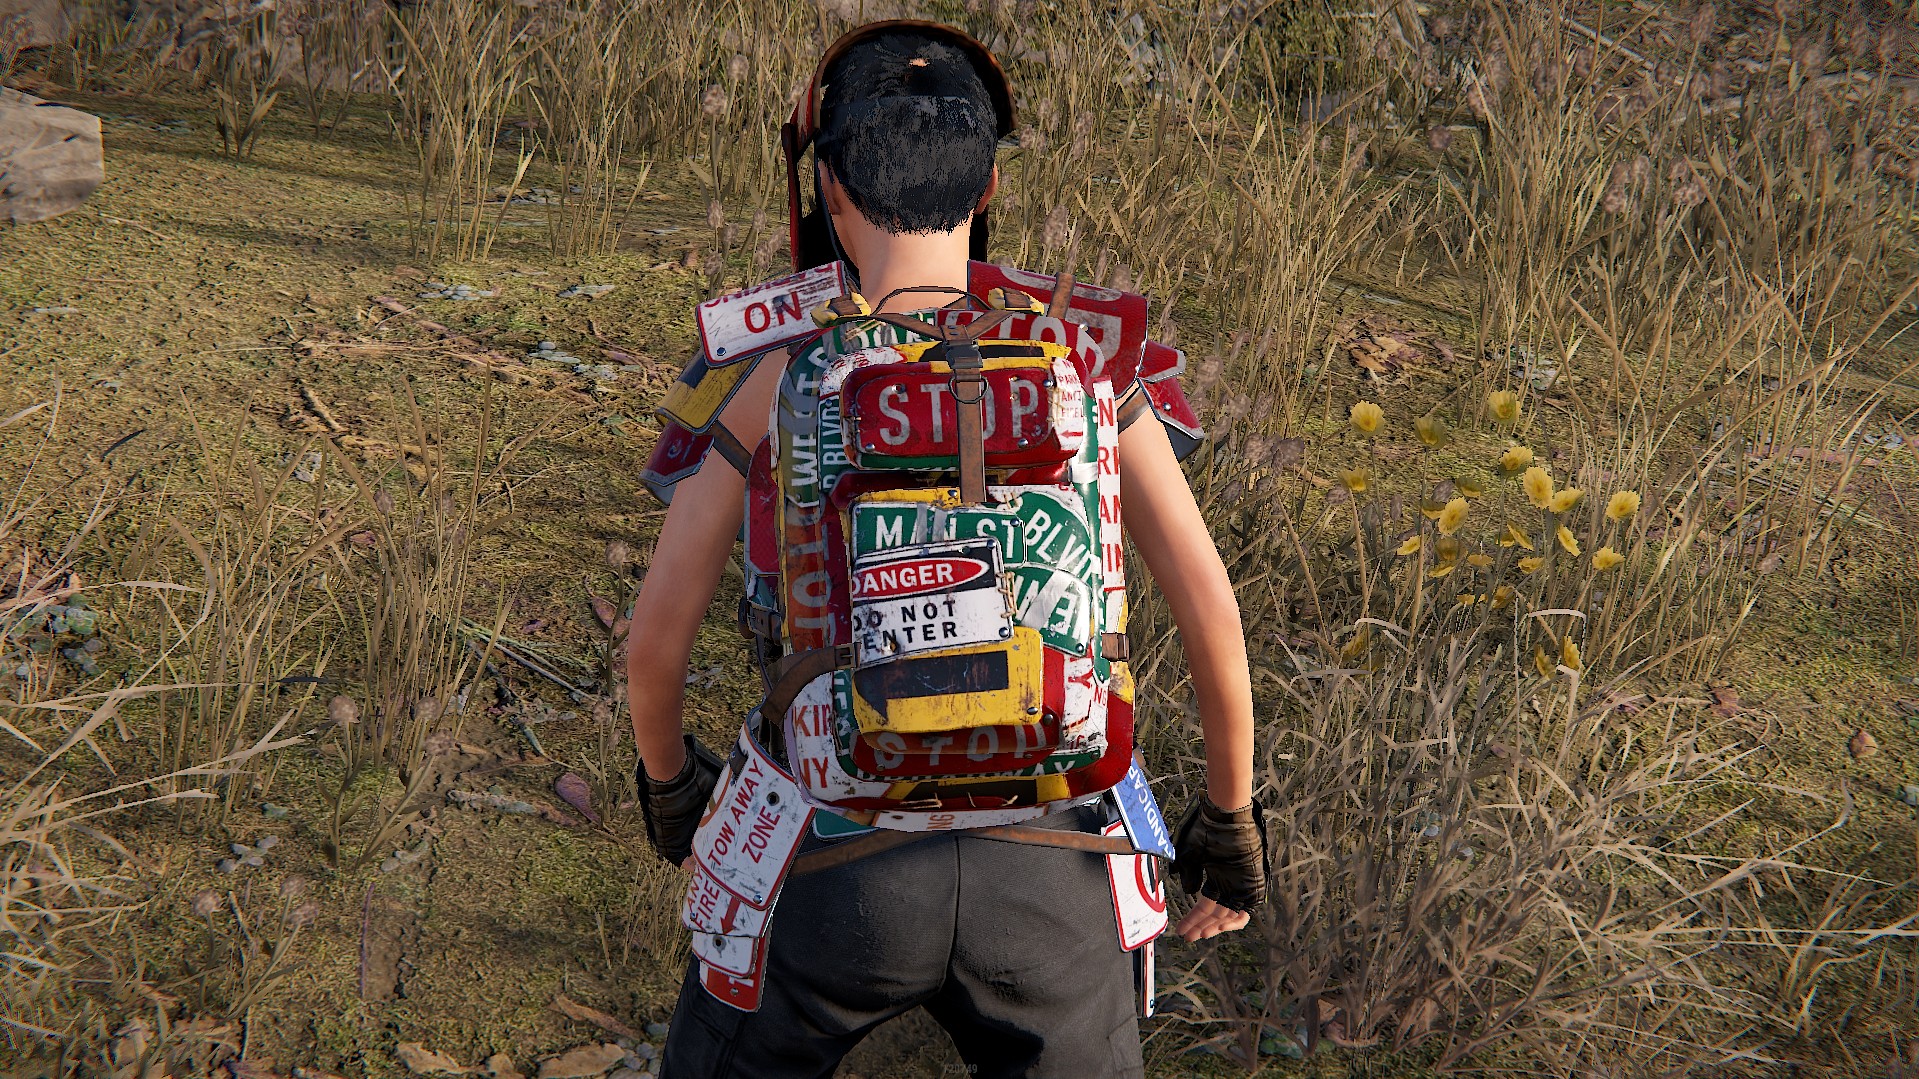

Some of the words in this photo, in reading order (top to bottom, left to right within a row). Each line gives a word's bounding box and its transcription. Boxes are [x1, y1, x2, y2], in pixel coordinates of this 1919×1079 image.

[744, 291, 803, 335] ON
[791, 372, 820, 487] WET
[876, 515, 957, 549] MN
[852, 563, 955, 595] DANGER
[901, 600, 956, 623] NOT
[864, 621, 957, 650] ENTER
[874, 722, 1048, 770] STOP
[708, 821, 736, 867] TOW
[731, 757, 765, 825] AWAY
[741, 805, 781, 864] ZONE
[692, 880, 721, 930] FIRE
